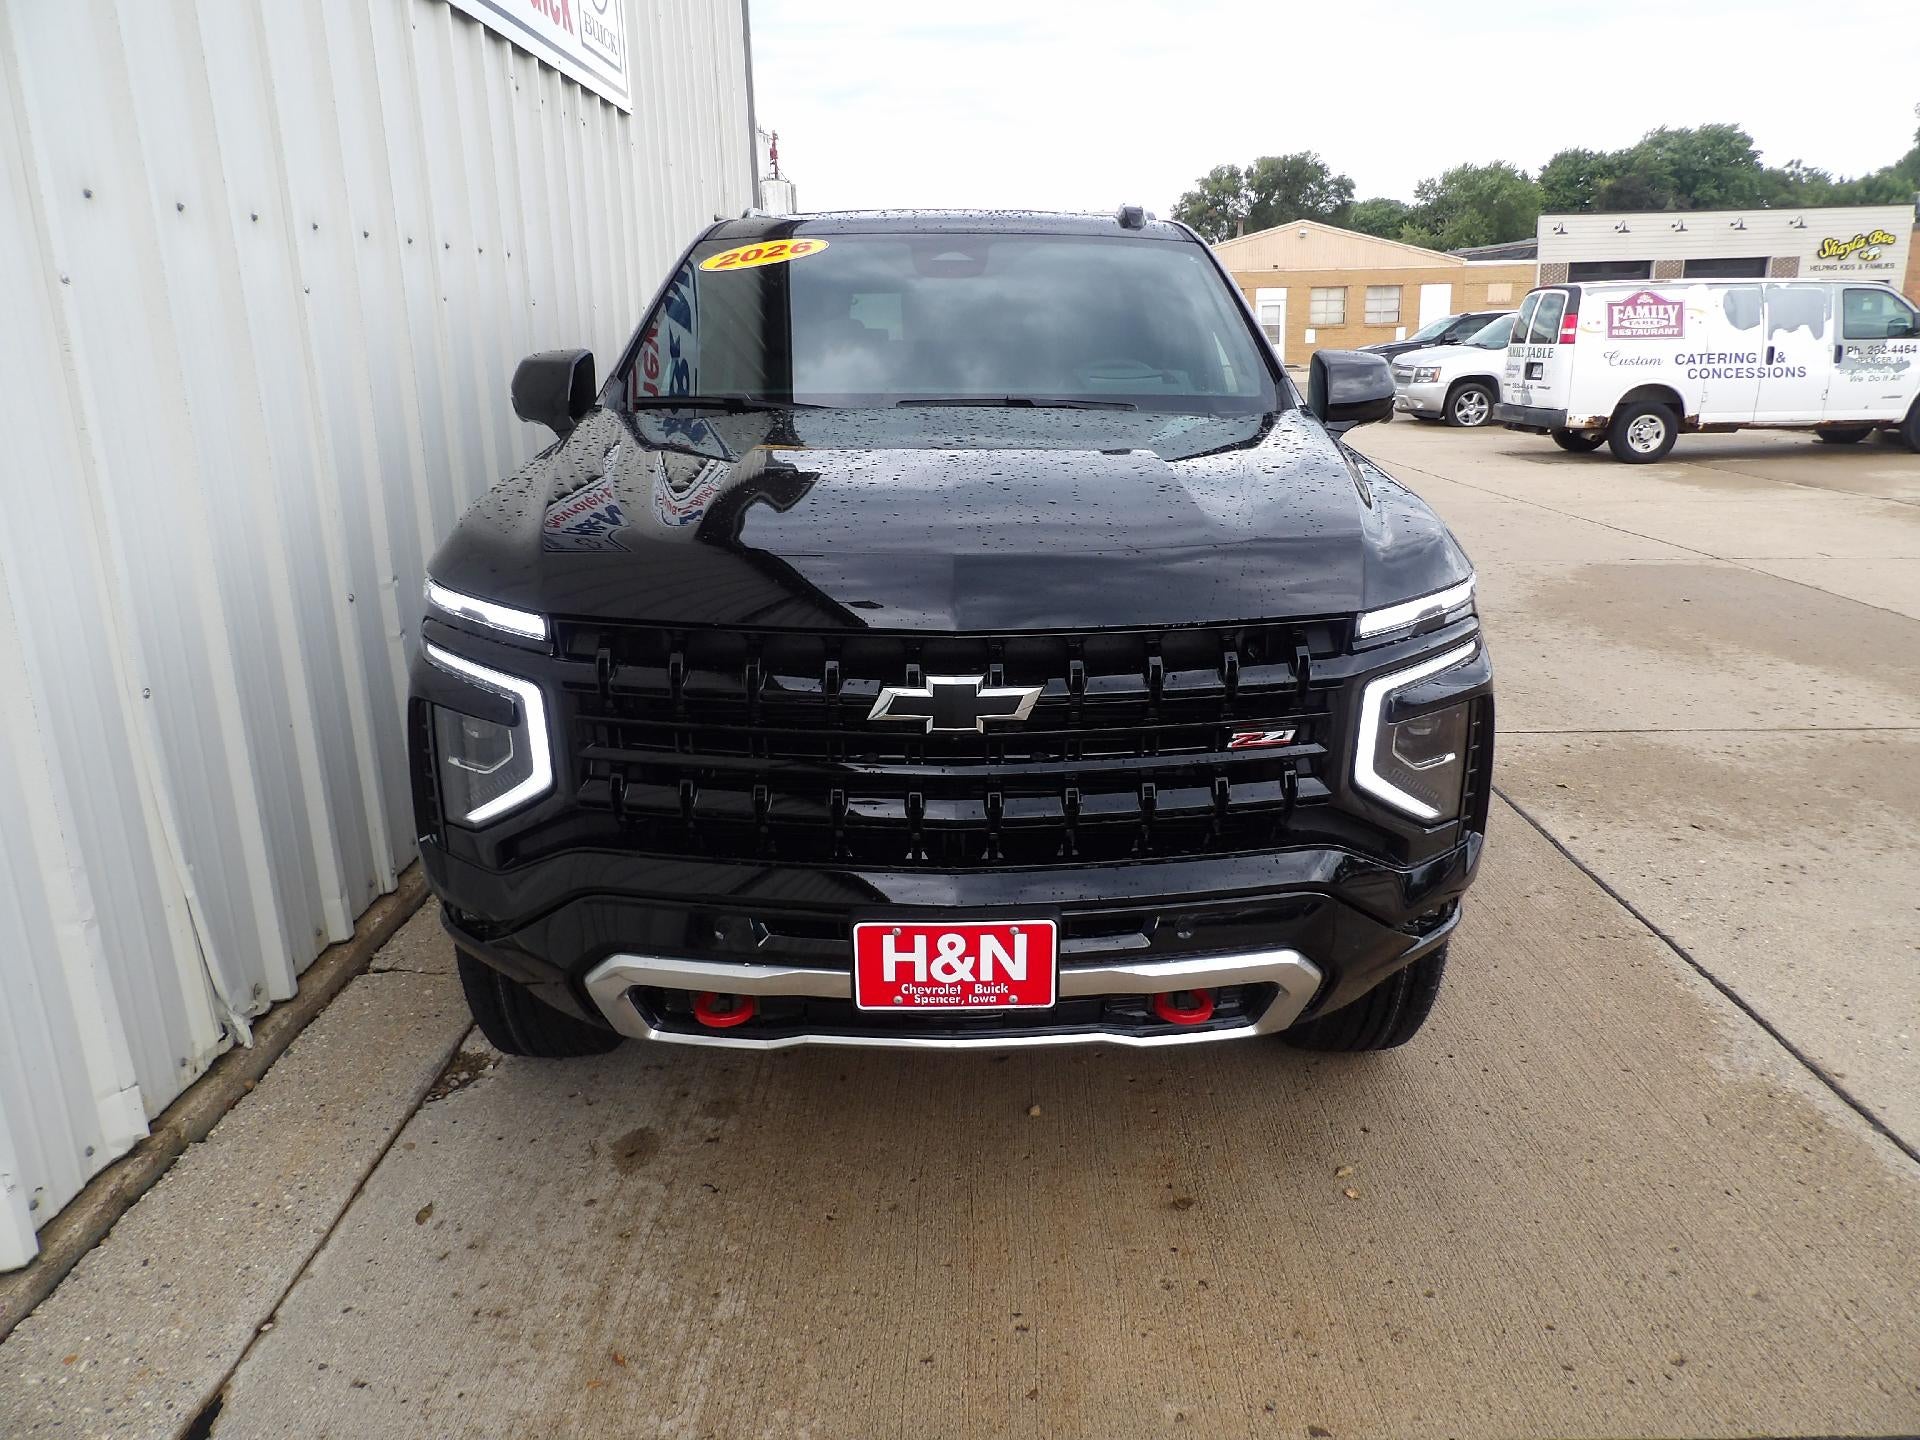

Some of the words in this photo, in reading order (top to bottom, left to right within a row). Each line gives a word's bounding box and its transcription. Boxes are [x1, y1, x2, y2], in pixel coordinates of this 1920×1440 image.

[583, 10, 618, 56] BUICK
[1818, 233, 1867, 260] Shayla
[1867, 229, 1897, 246] Bee
[714, 241, 813, 269] 2026
[1809, 264, 1838, 272] HELPING
[1840, 263, 1856, 271] KIDS
[1865, 262, 1896, 270] FAMILIES
[1612, 304, 1680, 327] FAMILY
[1612, 327, 1680, 336] RESTAURANT
[1528, 346, 1555, 359] TABLE
[1603, 350, 1664, 367] Custom
[1674, 352, 1758, 366] CATERING
[1776, 351, 1787, 364] &
[1687, 366, 1807, 380] CONCESSIONS
[882, 933, 1028, 984] H&N
[901, 983, 962, 995] Chevrolet
[974, 982, 1009, 994] Buick
[914, 994, 965, 1005] Spencer,
[968, 994, 997, 1004] Iowa
